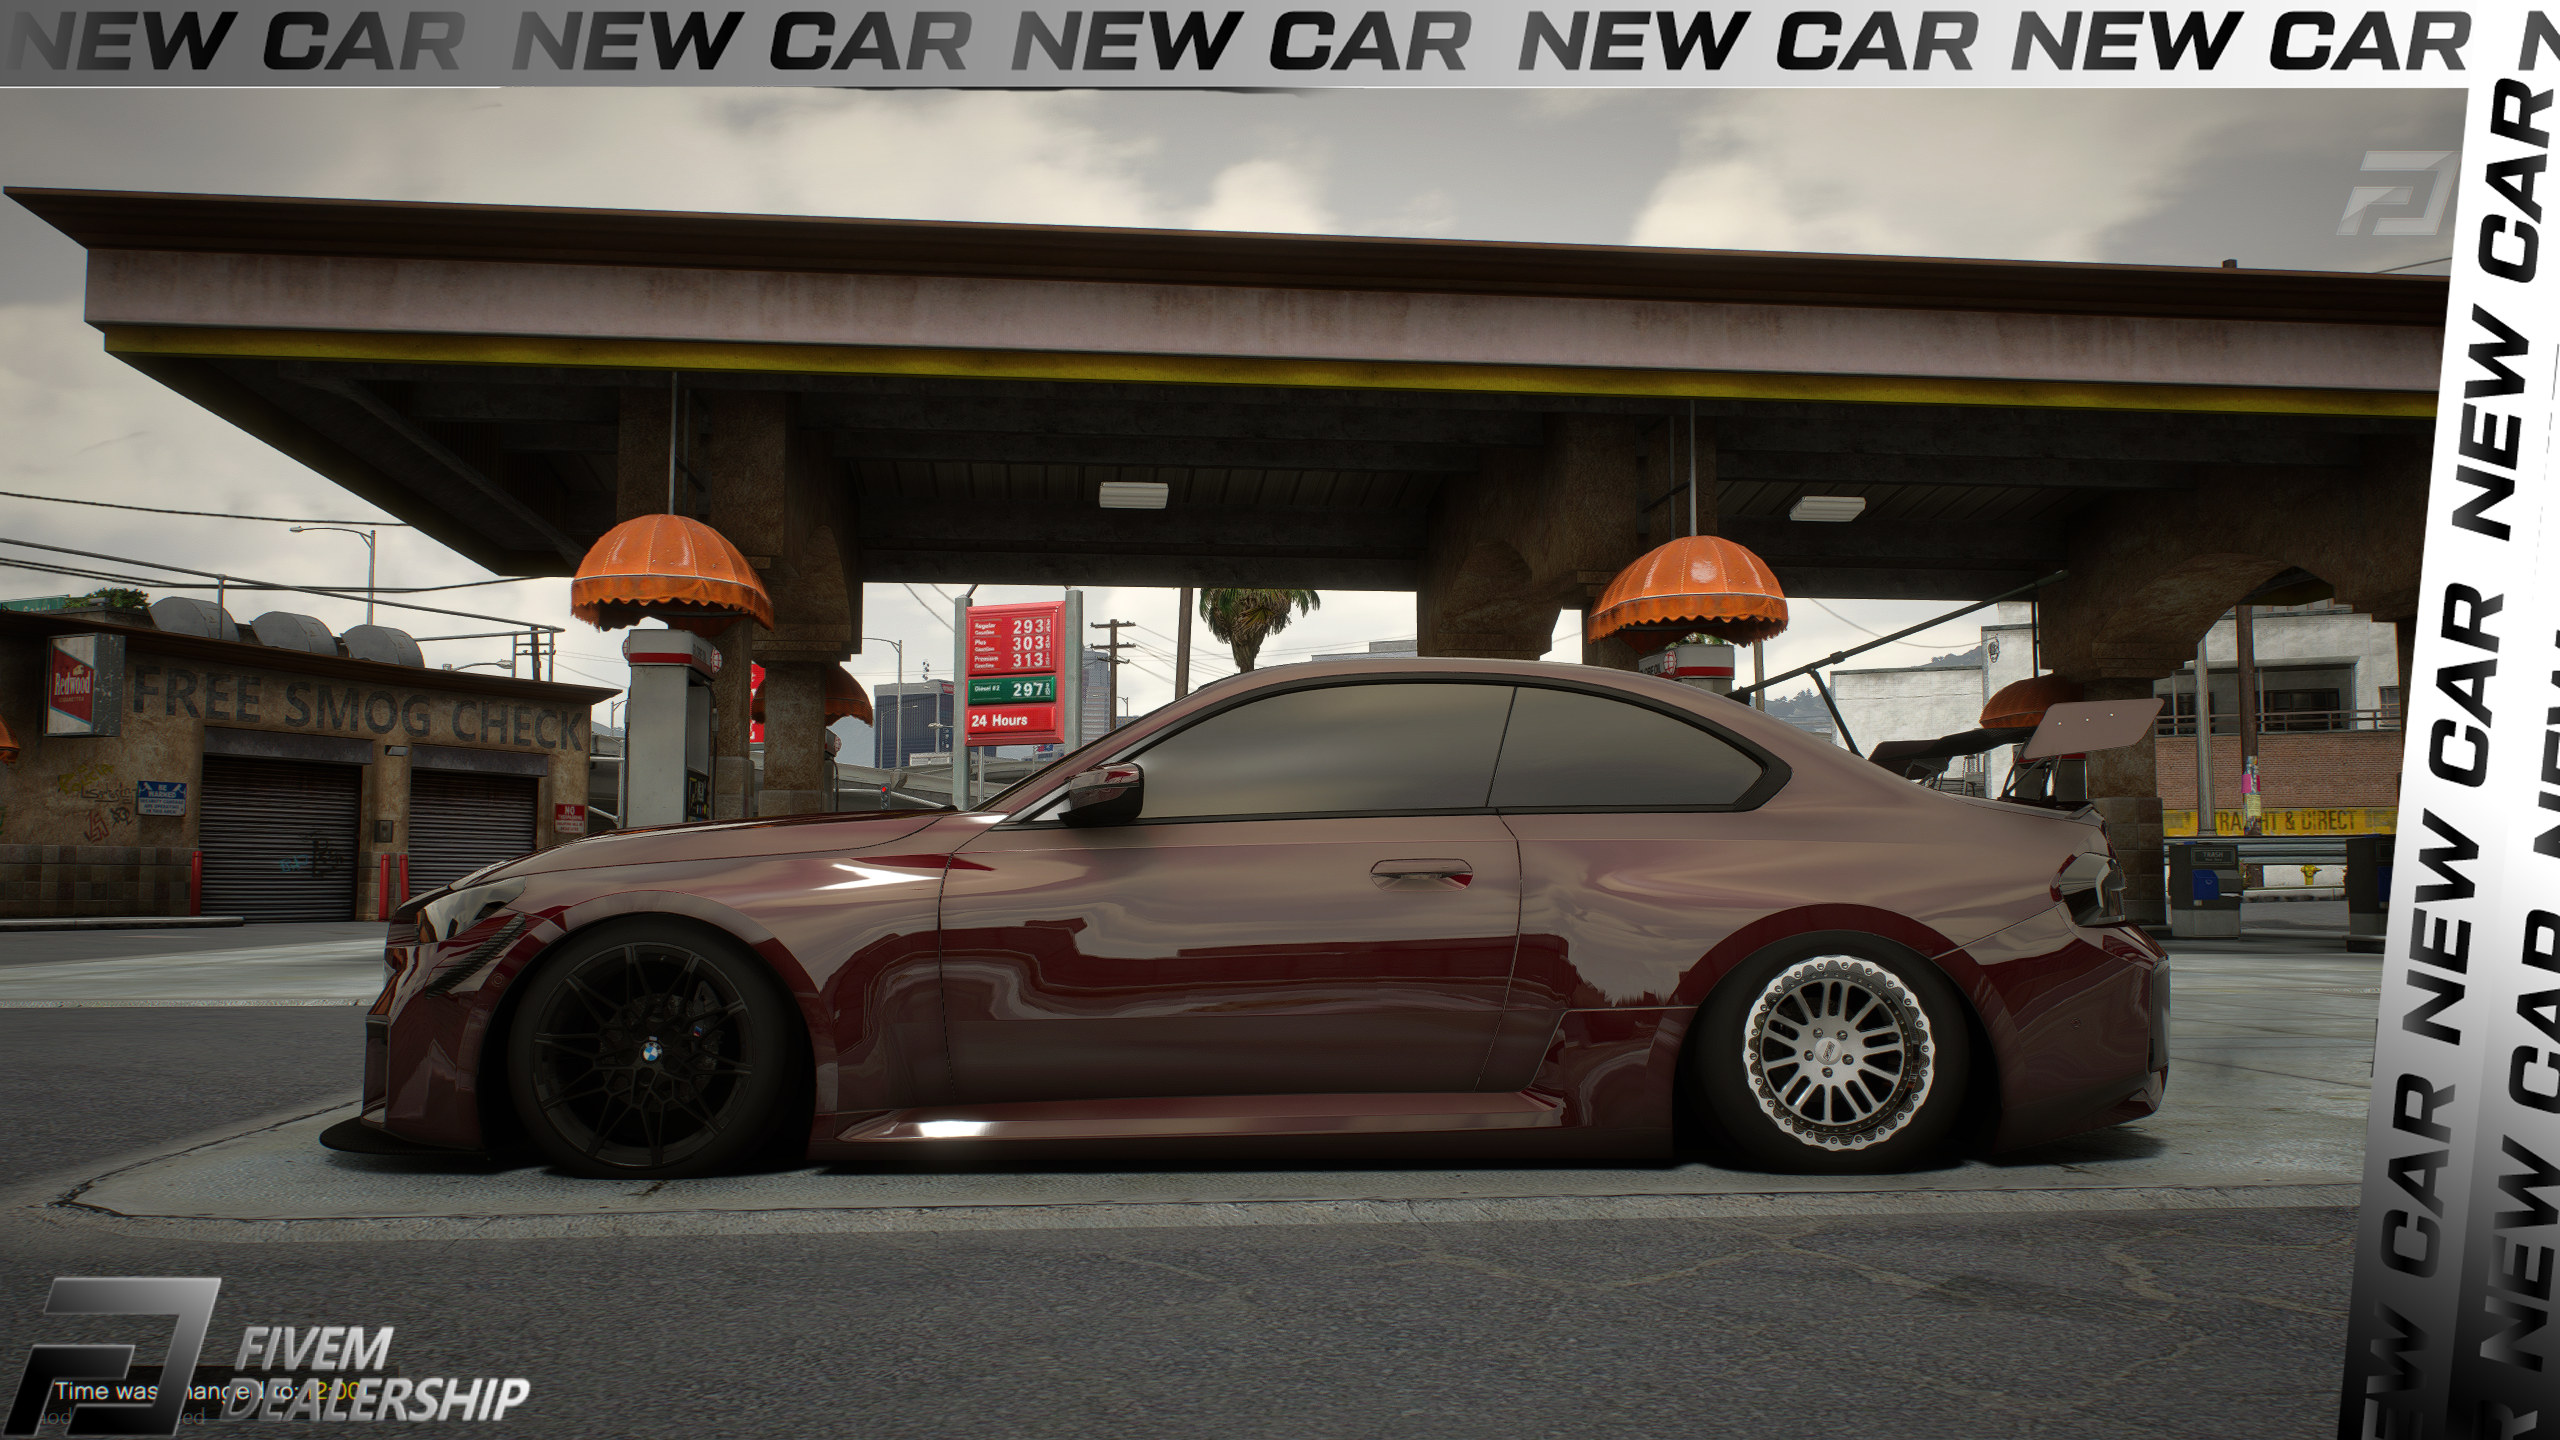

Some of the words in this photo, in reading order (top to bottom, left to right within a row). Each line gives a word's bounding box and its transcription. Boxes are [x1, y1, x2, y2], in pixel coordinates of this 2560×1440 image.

[1013, 618, 1044, 635] 293
[1013, 635, 1044, 651] 303
[1013, 652, 1043, 667] 313
[54, 670, 91, 695] Redwood
[1013, 682, 1044, 697] 297
[133, 663, 262, 723] FREE
[284, 680, 432, 738] SMOG
[452, 699, 584, 752] CHECK
[971, 714, 987, 727] 24
[992, 713, 1028, 727] Hours
[148, 790, 177, 798] WARNED
[564, 805, 576, 816] NO
[2285, 811, 2296, 830] &
[2301, 810, 2357, 830] DIRECT
